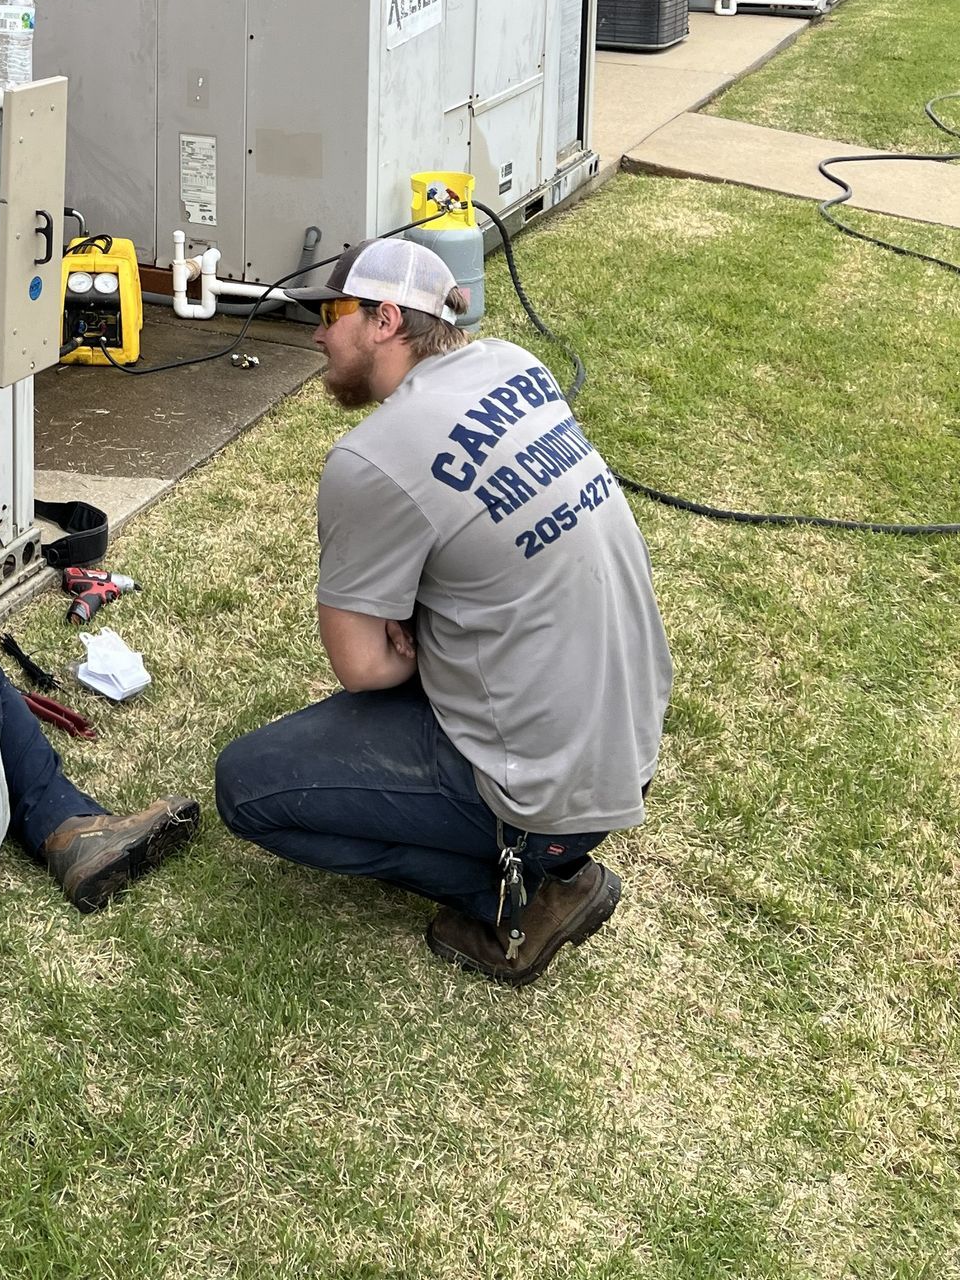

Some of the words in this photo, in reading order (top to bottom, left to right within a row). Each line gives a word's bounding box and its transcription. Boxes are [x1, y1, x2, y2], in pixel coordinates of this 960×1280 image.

[474, 466, 537, 524] AIR
[515, 416, 595, 487] CONDITI
[515, 468, 613, 560] 205-427-
